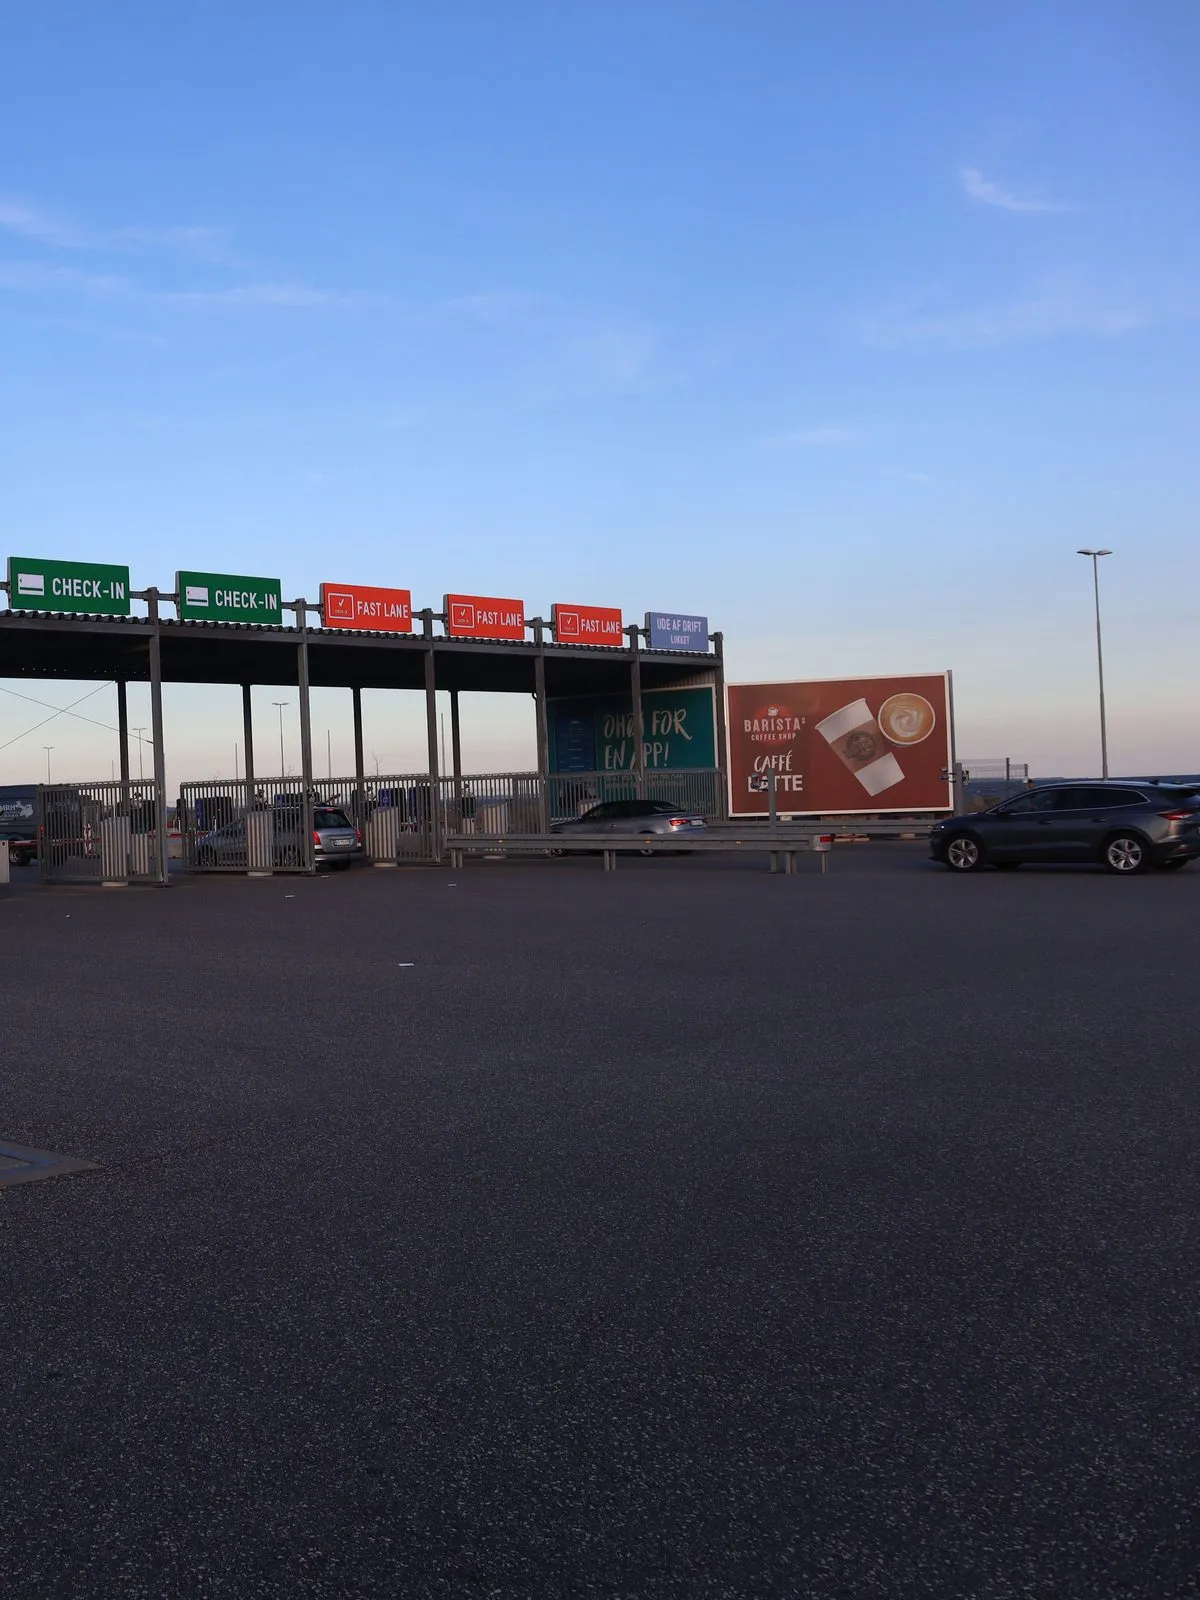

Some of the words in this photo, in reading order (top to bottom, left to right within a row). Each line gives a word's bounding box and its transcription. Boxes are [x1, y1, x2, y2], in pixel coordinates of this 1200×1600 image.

[52, 577, 125, 600] CHECK-IN
[215, 590, 277, 610] CHECK-IN
[357, 600, 381, 617] FAST
[384, 603, 409, 618] LANE
[477, 610, 498, 625] FAST
[500, 612, 522, 627] LANE
[581, 618, 599, 632] FAST
[601, 620, 620, 634] LANE
[656, 617, 670, 630] UDE
[672, 619, 681, 631] AF
[683, 620, 702, 633] DRIFT
[670, 635, 689, 645] LUKKET
[652, 709, 692, 740] FOR
[751, 733, 776, 741] COFFEE
[605, 741, 625, 770] EN
[754, 750, 793, 773] CAFFÉ
